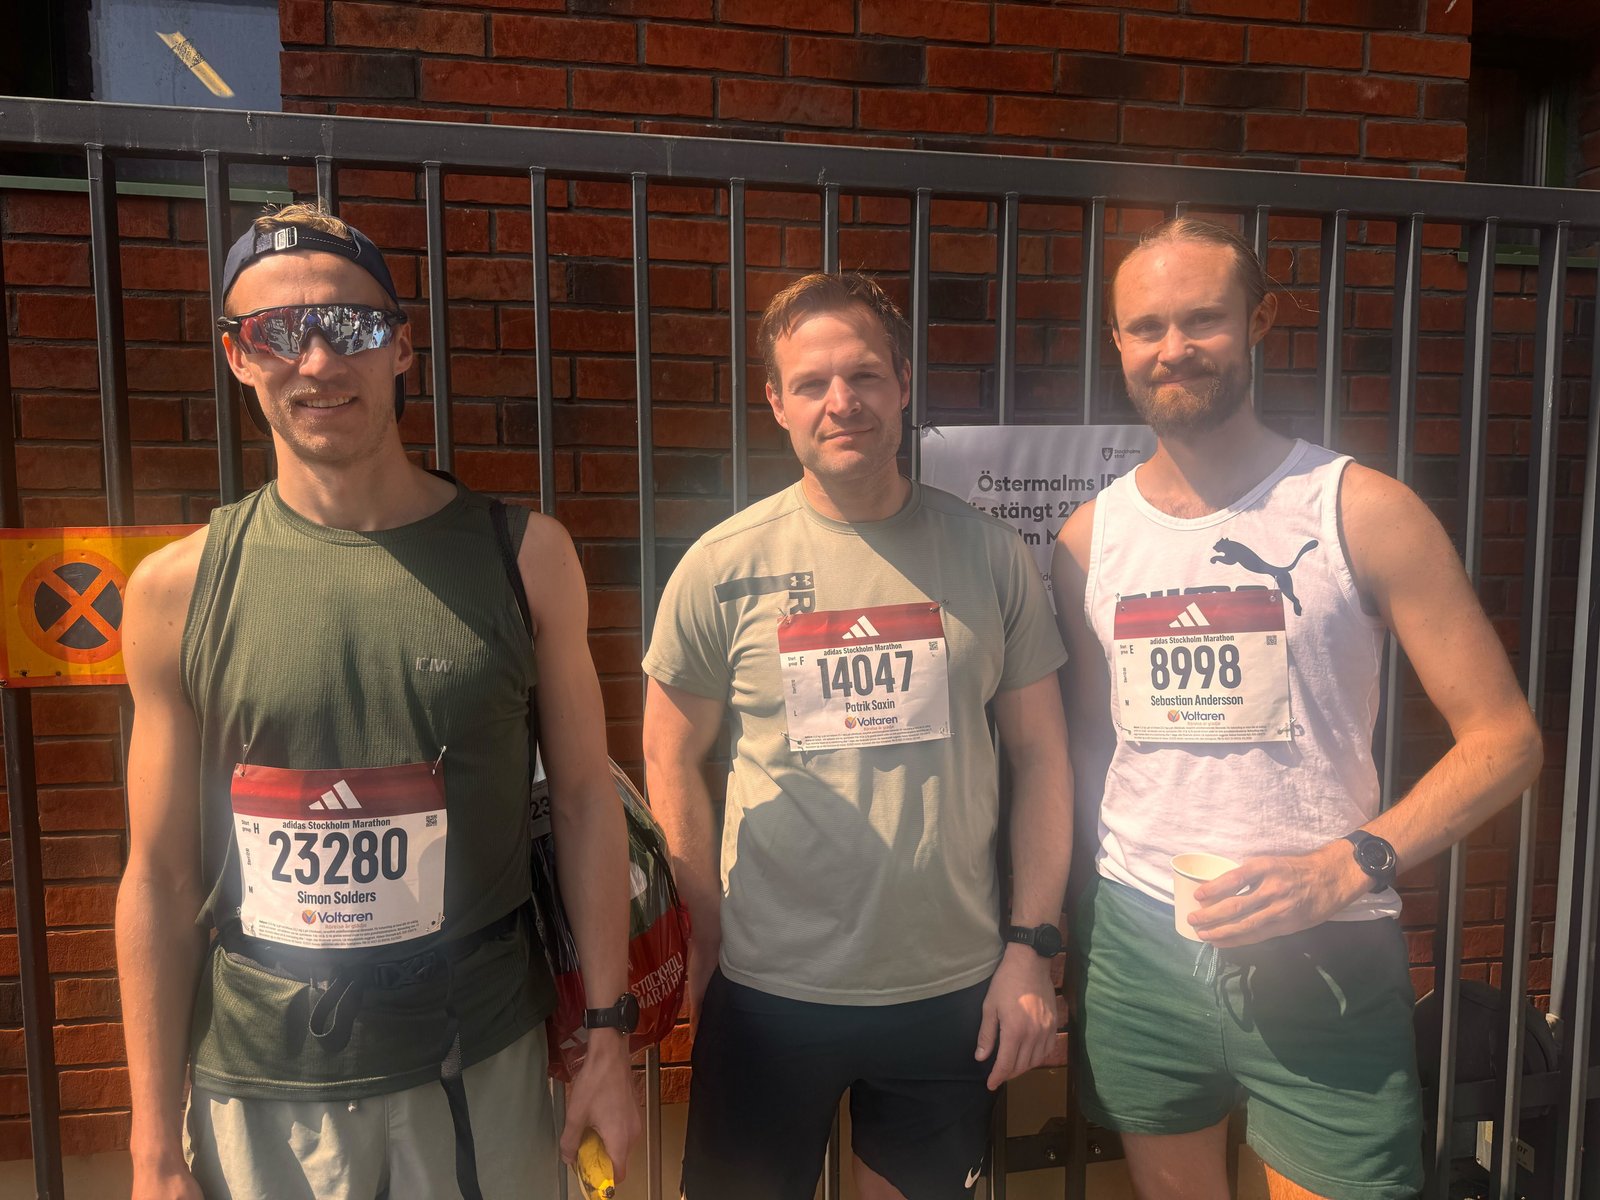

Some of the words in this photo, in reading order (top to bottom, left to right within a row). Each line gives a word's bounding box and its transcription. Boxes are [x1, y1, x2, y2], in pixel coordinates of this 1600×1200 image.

[978, 471, 1095, 492] Östermalms
[991, 502, 1053, 522] stängt
[1058, 501, 1087, 518] 27
[1150, 637, 1168, 645] adidas
[1169, 636, 1202, 644] Stockholm
[1203, 635, 1235, 643] Marathon
[823, 648, 842, 656] adidas
[843, 646, 874, 655] Stockholm
[874, 642, 903, 652] Marathon
[1129, 644, 1135, 655] E
[799, 656, 805, 666] F
[1150, 644, 1242, 690] 8998
[816, 650, 914, 699] 14047
[845, 700, 871, 713] Patrik
[872, 698, 896, 711] Saxin
[1150, 695, 1194, 707] Sebastian
[1195, 694, 1244, 706] Andersson
[857, 715, 898, 727] Voltaren
[1180, 711, 1226, 721] Voltaren
[253, 822, 260, 835] H
[282, 820, 306, 830] adidas
[308, 820, 350, 830] Stockholm
[352, 818, 391, 828] Marathon
[268, 827, 408, 885] 23280
[297, 890, 332, 905] Simon
[333, 890, 377, 904] Solders
[317, 911, 374, 924] Voltaren
[637, 966, 685, 1009] MARATH
